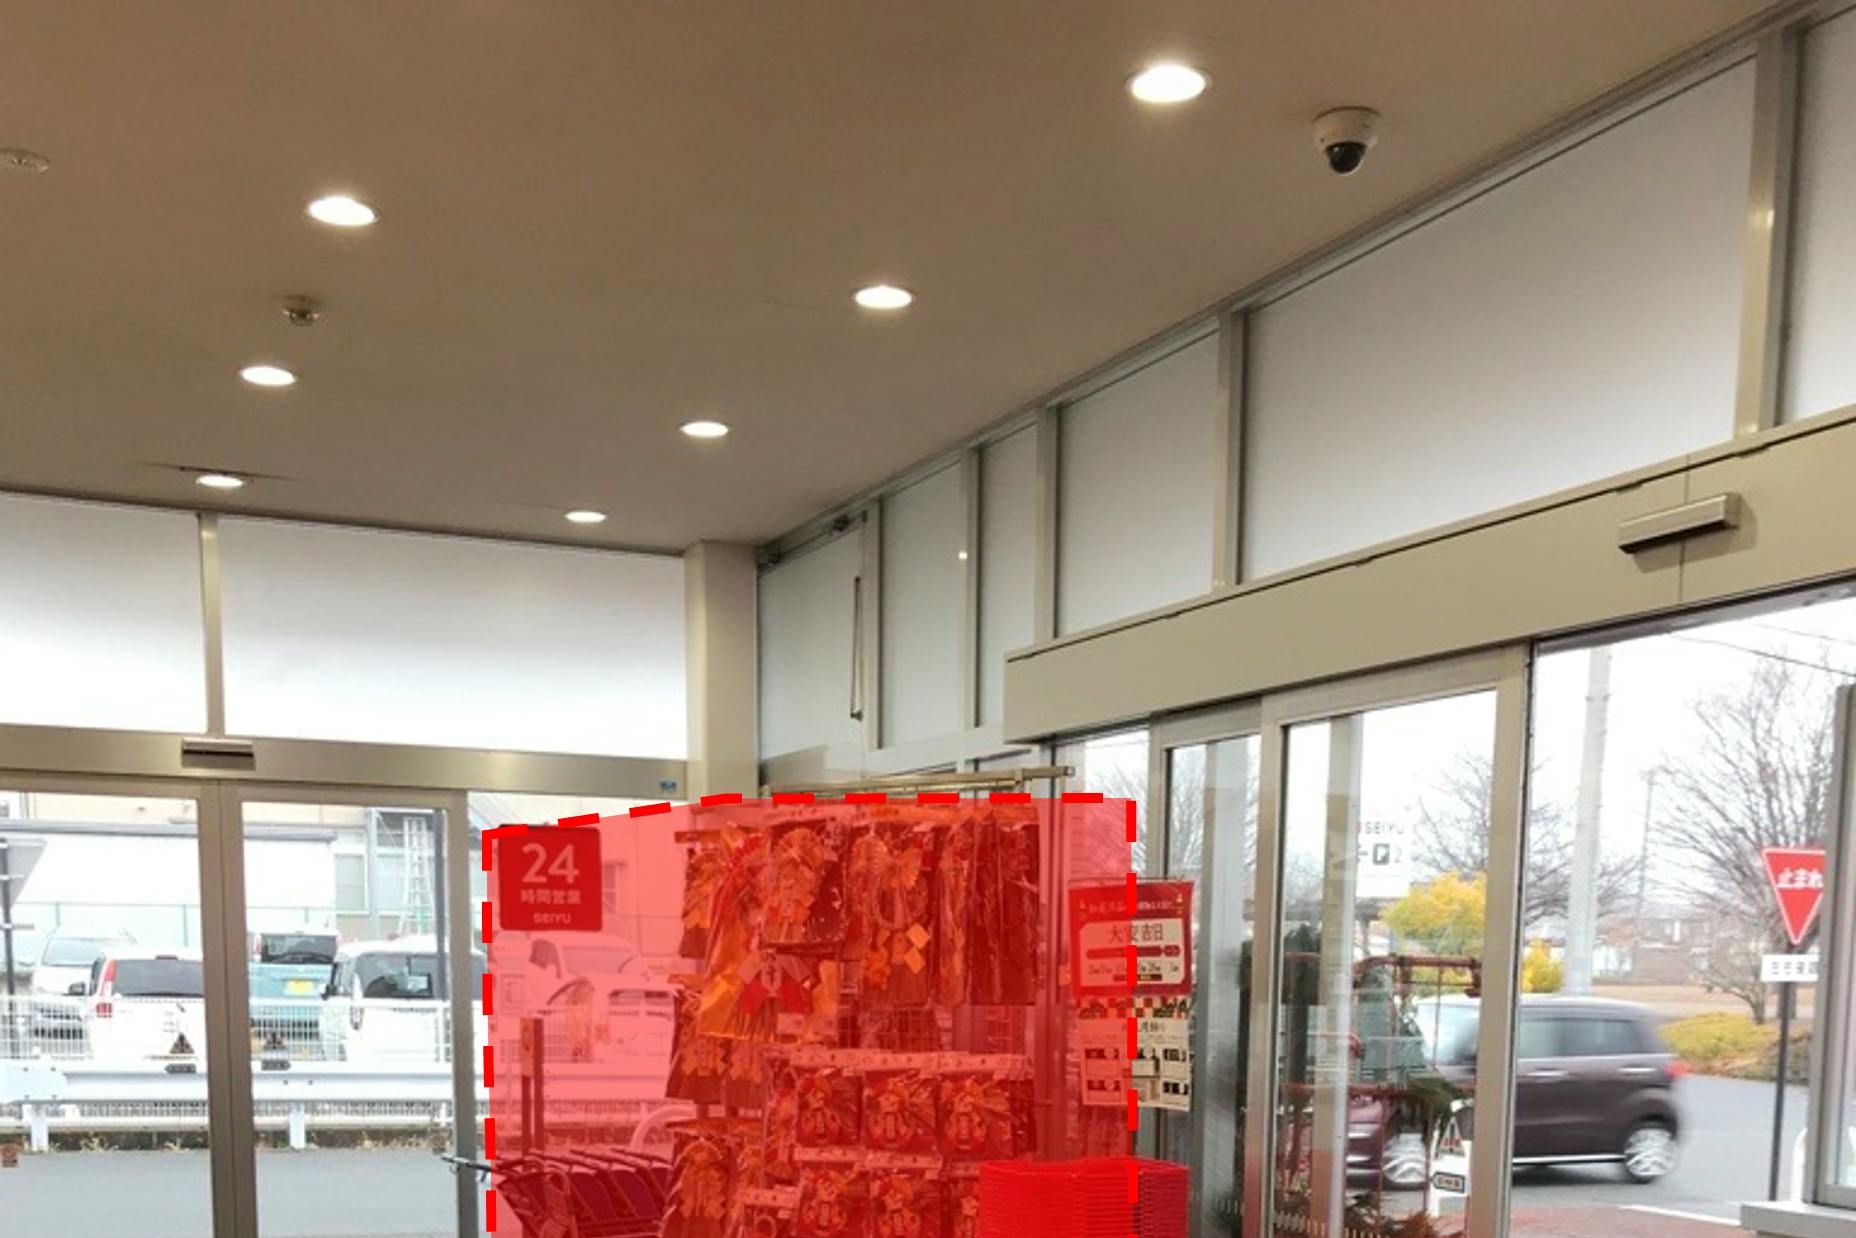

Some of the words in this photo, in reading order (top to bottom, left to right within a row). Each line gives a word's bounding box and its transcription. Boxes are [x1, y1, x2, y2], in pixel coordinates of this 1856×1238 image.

[1365, 821, 1404, 834] SEIYU
[521, 843, 579, 884] 24
[1776, 868, 1824, 889] 止まれ
[521, 889, 581, 905] 時間営業
[533, 913, 572, 924] SEIYU
